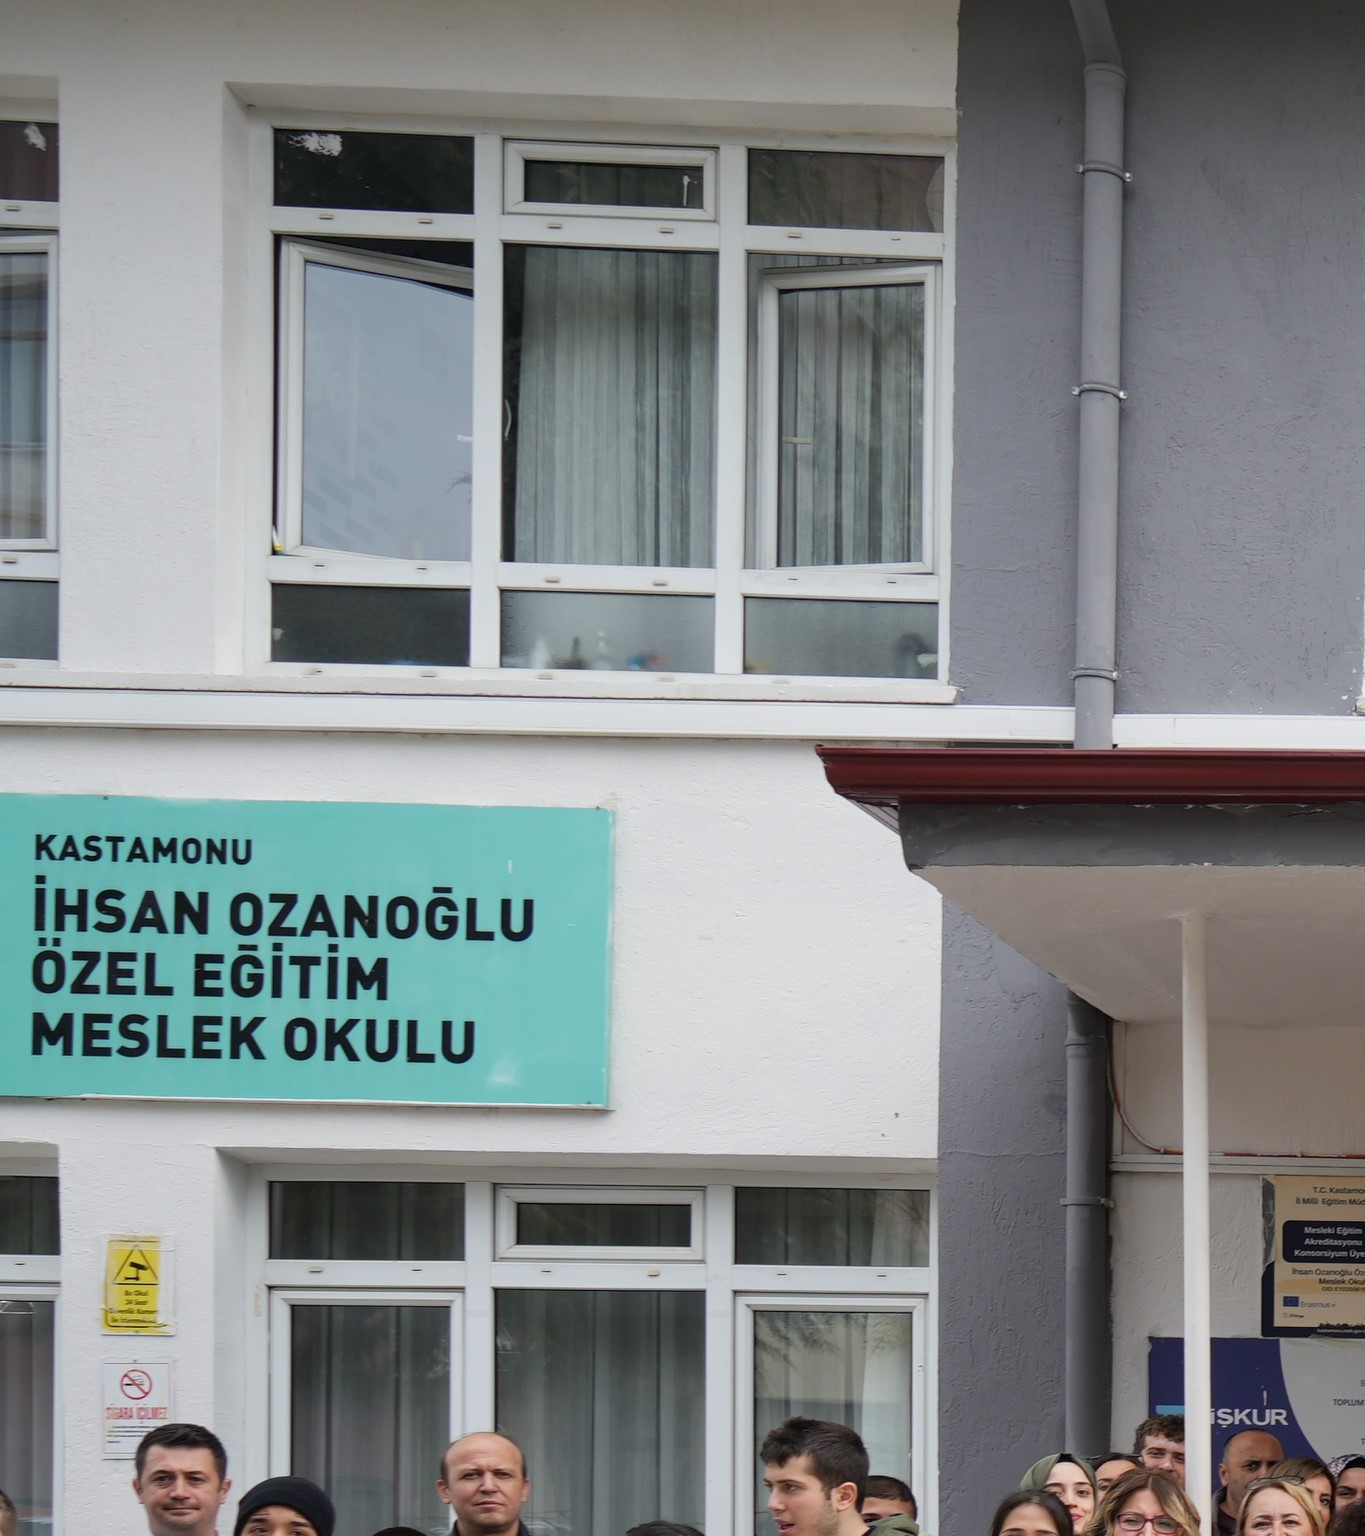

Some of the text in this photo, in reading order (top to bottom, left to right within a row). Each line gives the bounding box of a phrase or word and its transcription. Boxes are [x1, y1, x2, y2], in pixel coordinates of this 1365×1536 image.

[35, 834, 252, 865] KASTAMONU
[34, 875, 535, 942] İHSAN OZANOĞLU
[32, 938, 389, 1000] ÖZEL EĞİTİM
[31, 1012, 475, 1064] MESLEK OKULU
[1312, 1186, 1328, 1194] T.C.
[1322, 1198, 1347, 1206] Eğitim
[1337, 1227, 1363, 1236] Eğitim
[1304, 1238, 1363, 1248] Akreditasyonu
[1294, 1249, 1348, 1258] Konsorsiyum
[1292, 1267, 1313, 1276] İhsan
[1315, 1268, 1352, 1278] Ozanoğlu
[1300, 1301, 1336, 1309] Erasmus+
[1332, 1399, 1364, 1407] TOPLUM
